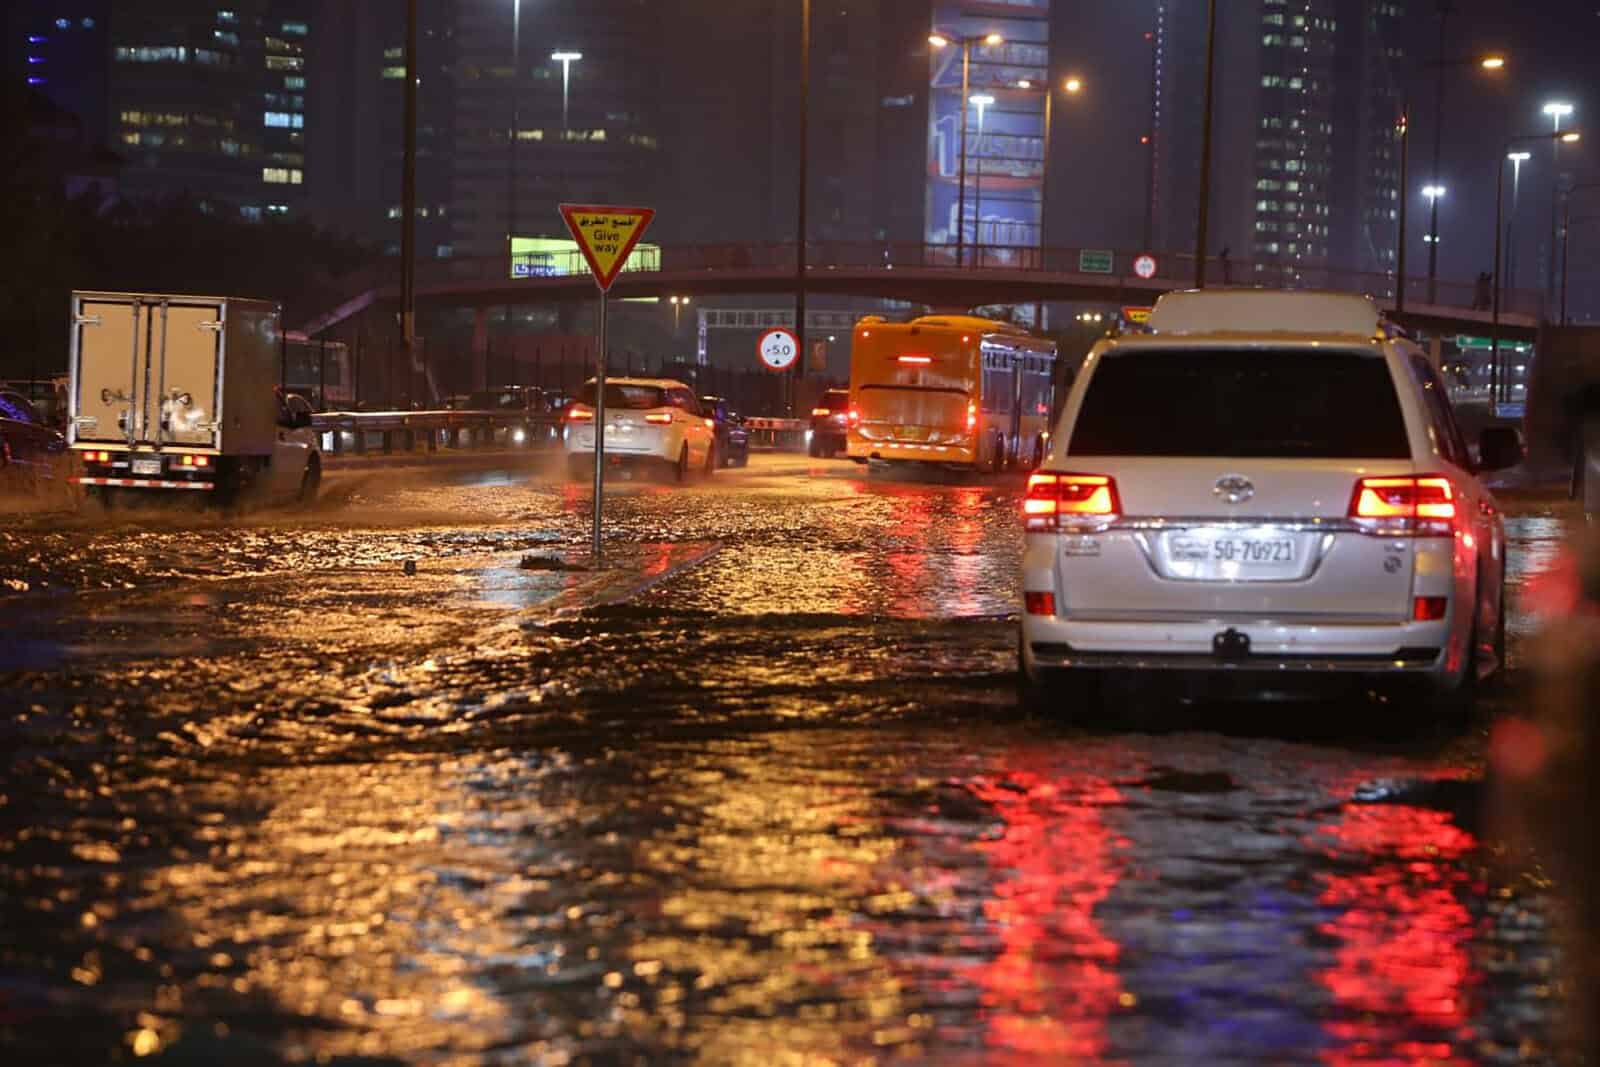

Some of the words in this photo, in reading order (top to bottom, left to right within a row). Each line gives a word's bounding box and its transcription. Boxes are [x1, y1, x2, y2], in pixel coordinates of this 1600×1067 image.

[593, 229, 620, 241] Give
[594, 244, 619, 255] way
[1215, 540, 1292, 561] 50-70921
